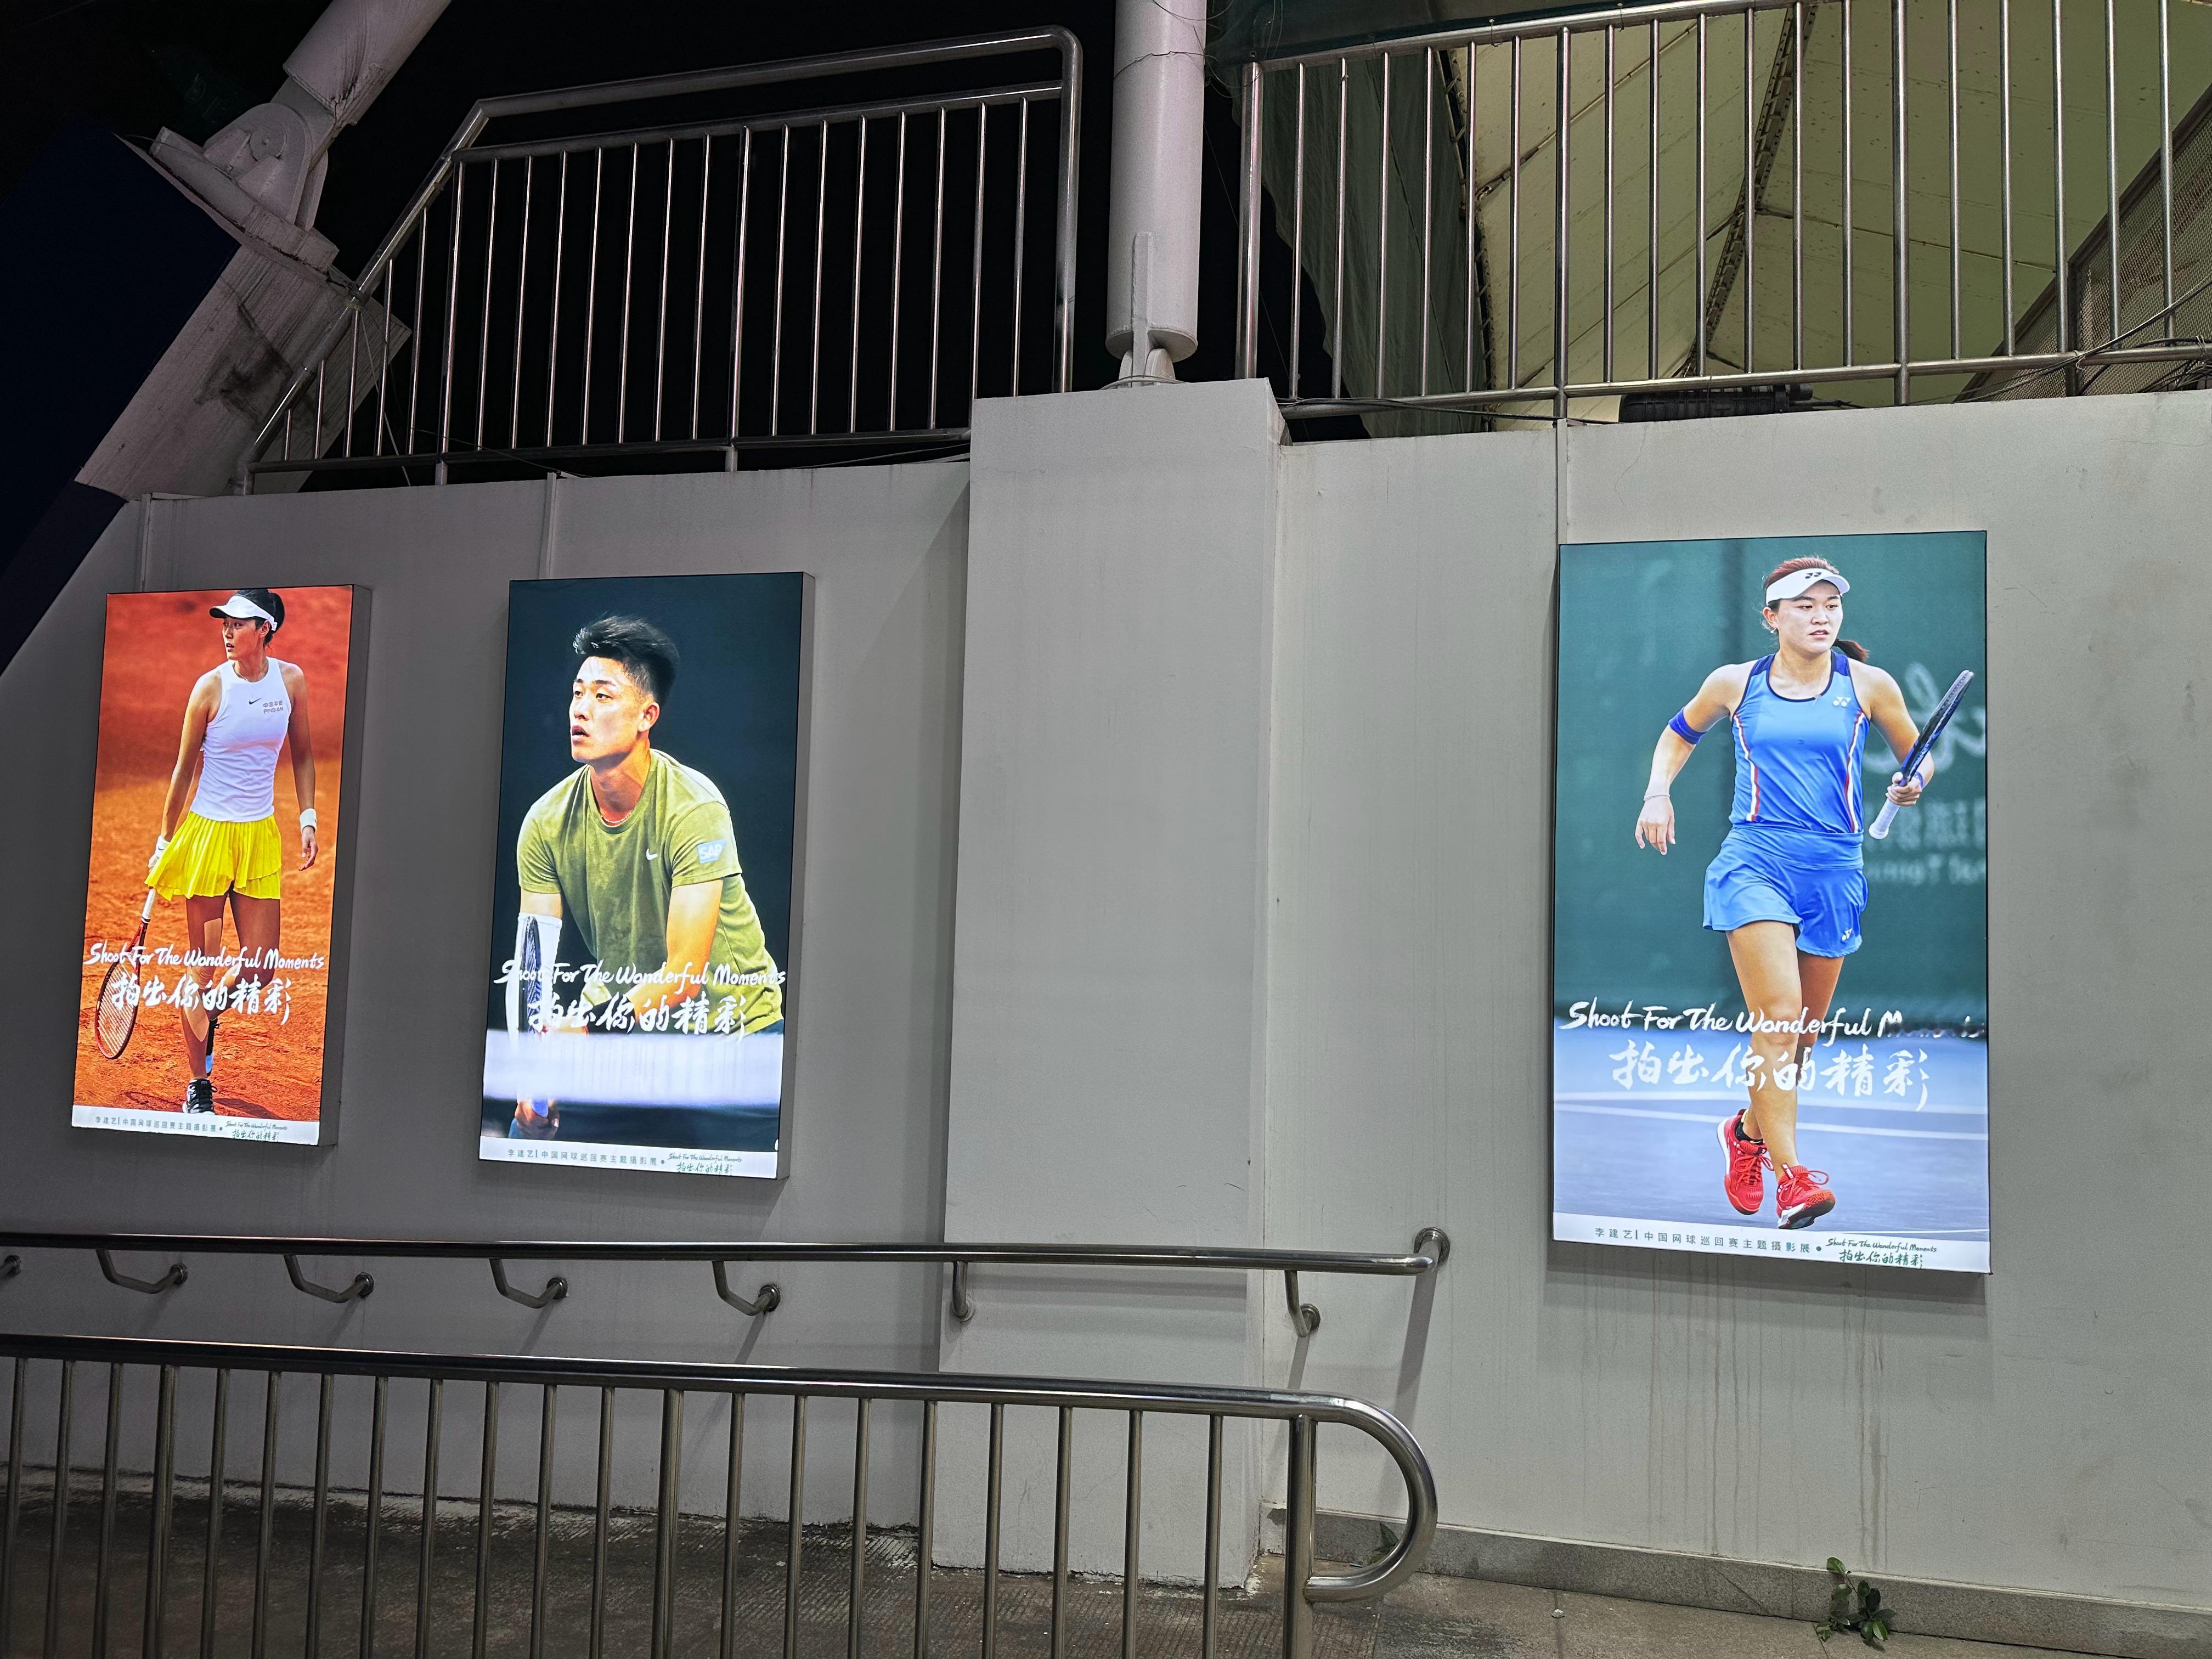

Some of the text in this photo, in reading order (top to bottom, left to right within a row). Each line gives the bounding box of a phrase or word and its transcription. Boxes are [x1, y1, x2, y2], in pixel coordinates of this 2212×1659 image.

[699, 843, 723, 859] SAP
[83, 939, 325, 977] Shoot For The Wonderful Moments
[552, 963, 581, 984] For
[580, 960, 614, 983] The
[615, 961, 709, 995] Wonderful
[713, 963, 786, 986] Moments
[111, 972, 292, 1025] 拍出你的精彩
[527, 991, 747, 1044] 拍出你的精彩
[1558, 996, 1644, 1029] Shoot
[1643, 1006, 1684, 1031] For
[1683, 1002, 1733, 1031] The
[1735, 1007, 1872, 1047] Wonderful
[1609, 1040, 1929, 1111] 拍出你的精彩
[699, 1154, 723, 1164] Wonderful
[1826, 1238, 1848, 1246] Shoot
[1872, 1241, 1908, 1252] Wonderful
[1909, 1244, 1937, 1252] Moments
[1839, 1249, 1923, 1268] 拍出你的精彩
